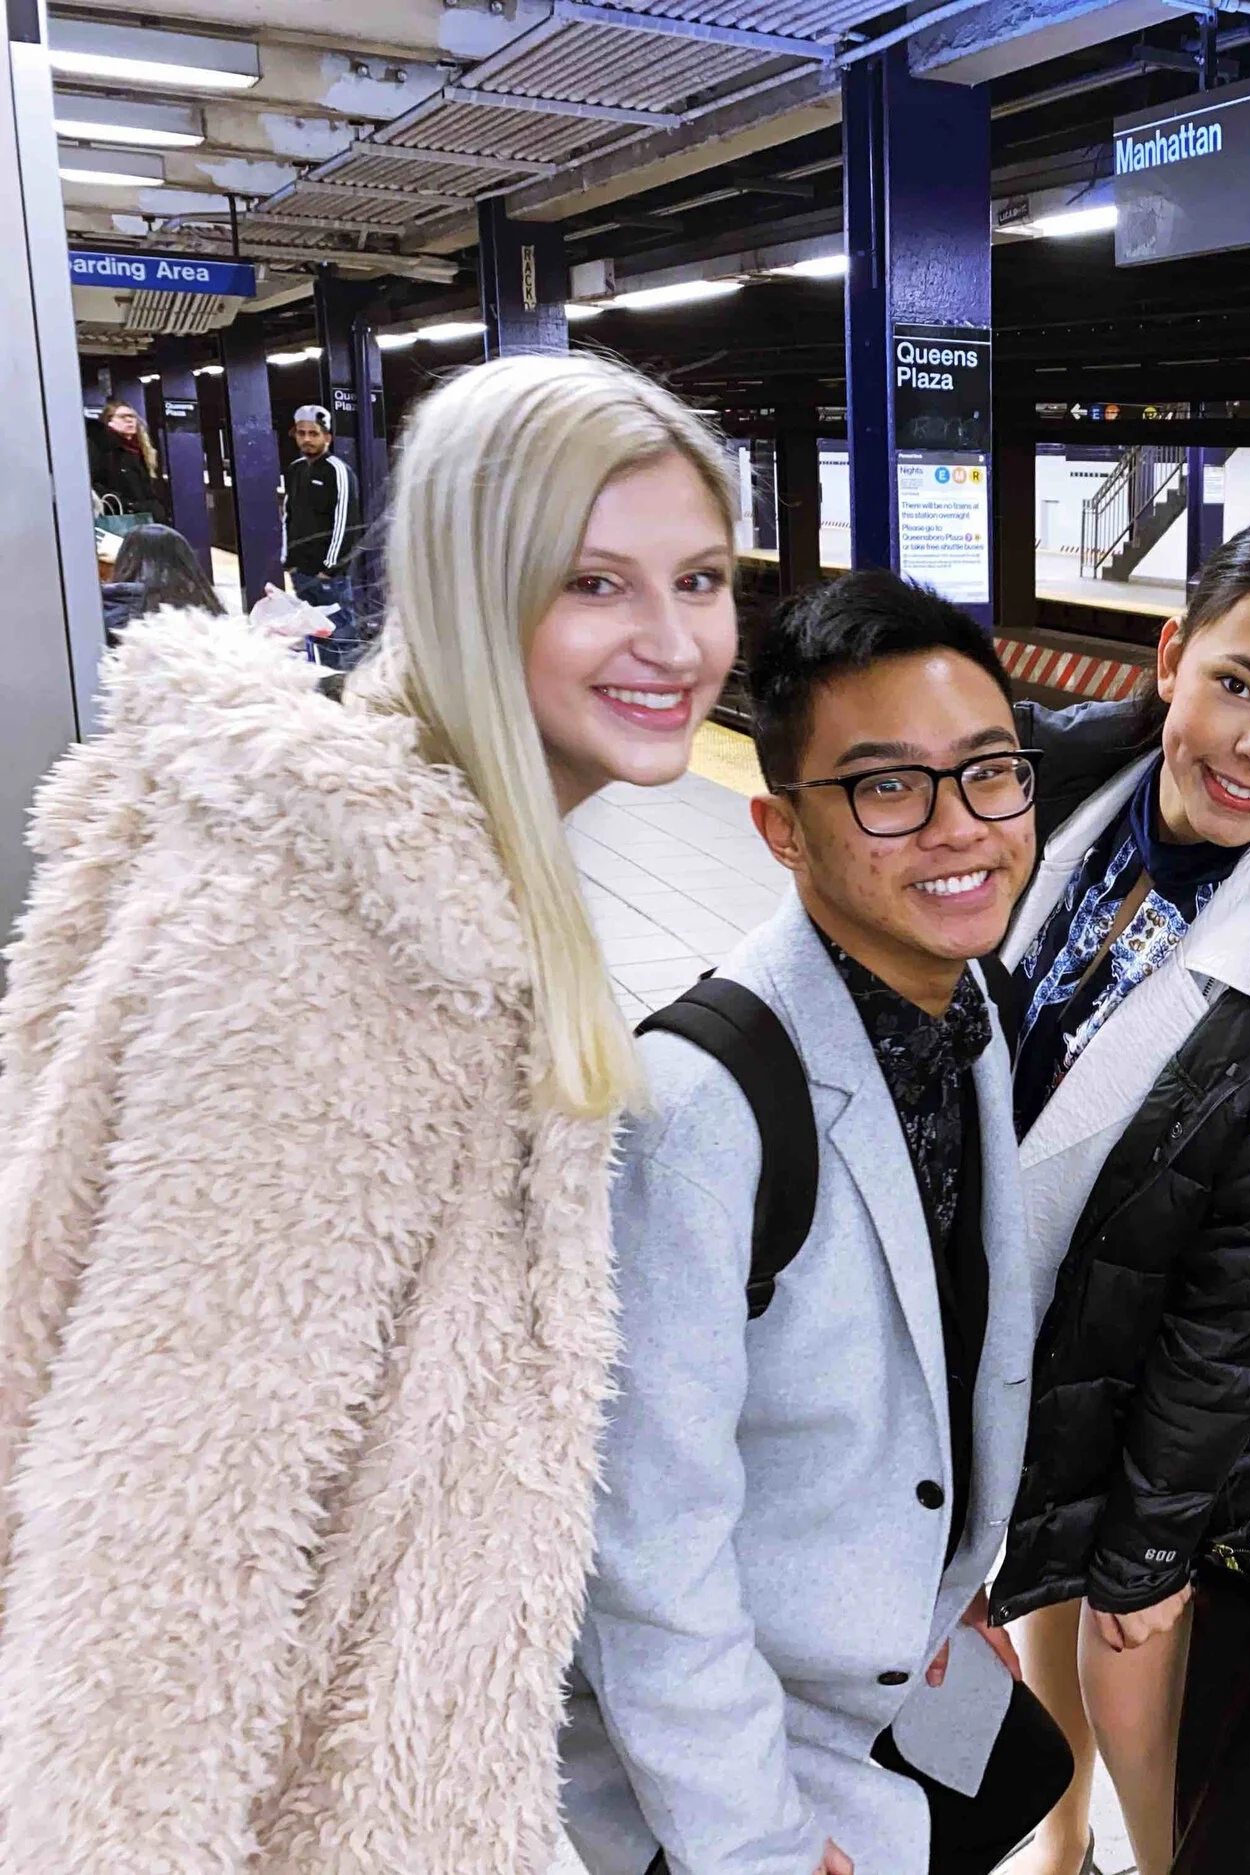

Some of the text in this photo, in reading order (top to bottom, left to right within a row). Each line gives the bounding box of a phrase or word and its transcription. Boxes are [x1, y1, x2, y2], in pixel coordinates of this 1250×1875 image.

[1115, 121, 1222, 175] Manhattan
[156, 261, 210, 282] Area
[896, 341, 978, 368] Queens
[897, 367, 954, 390] Plaza
[900, 467, 923, 475] Nights
